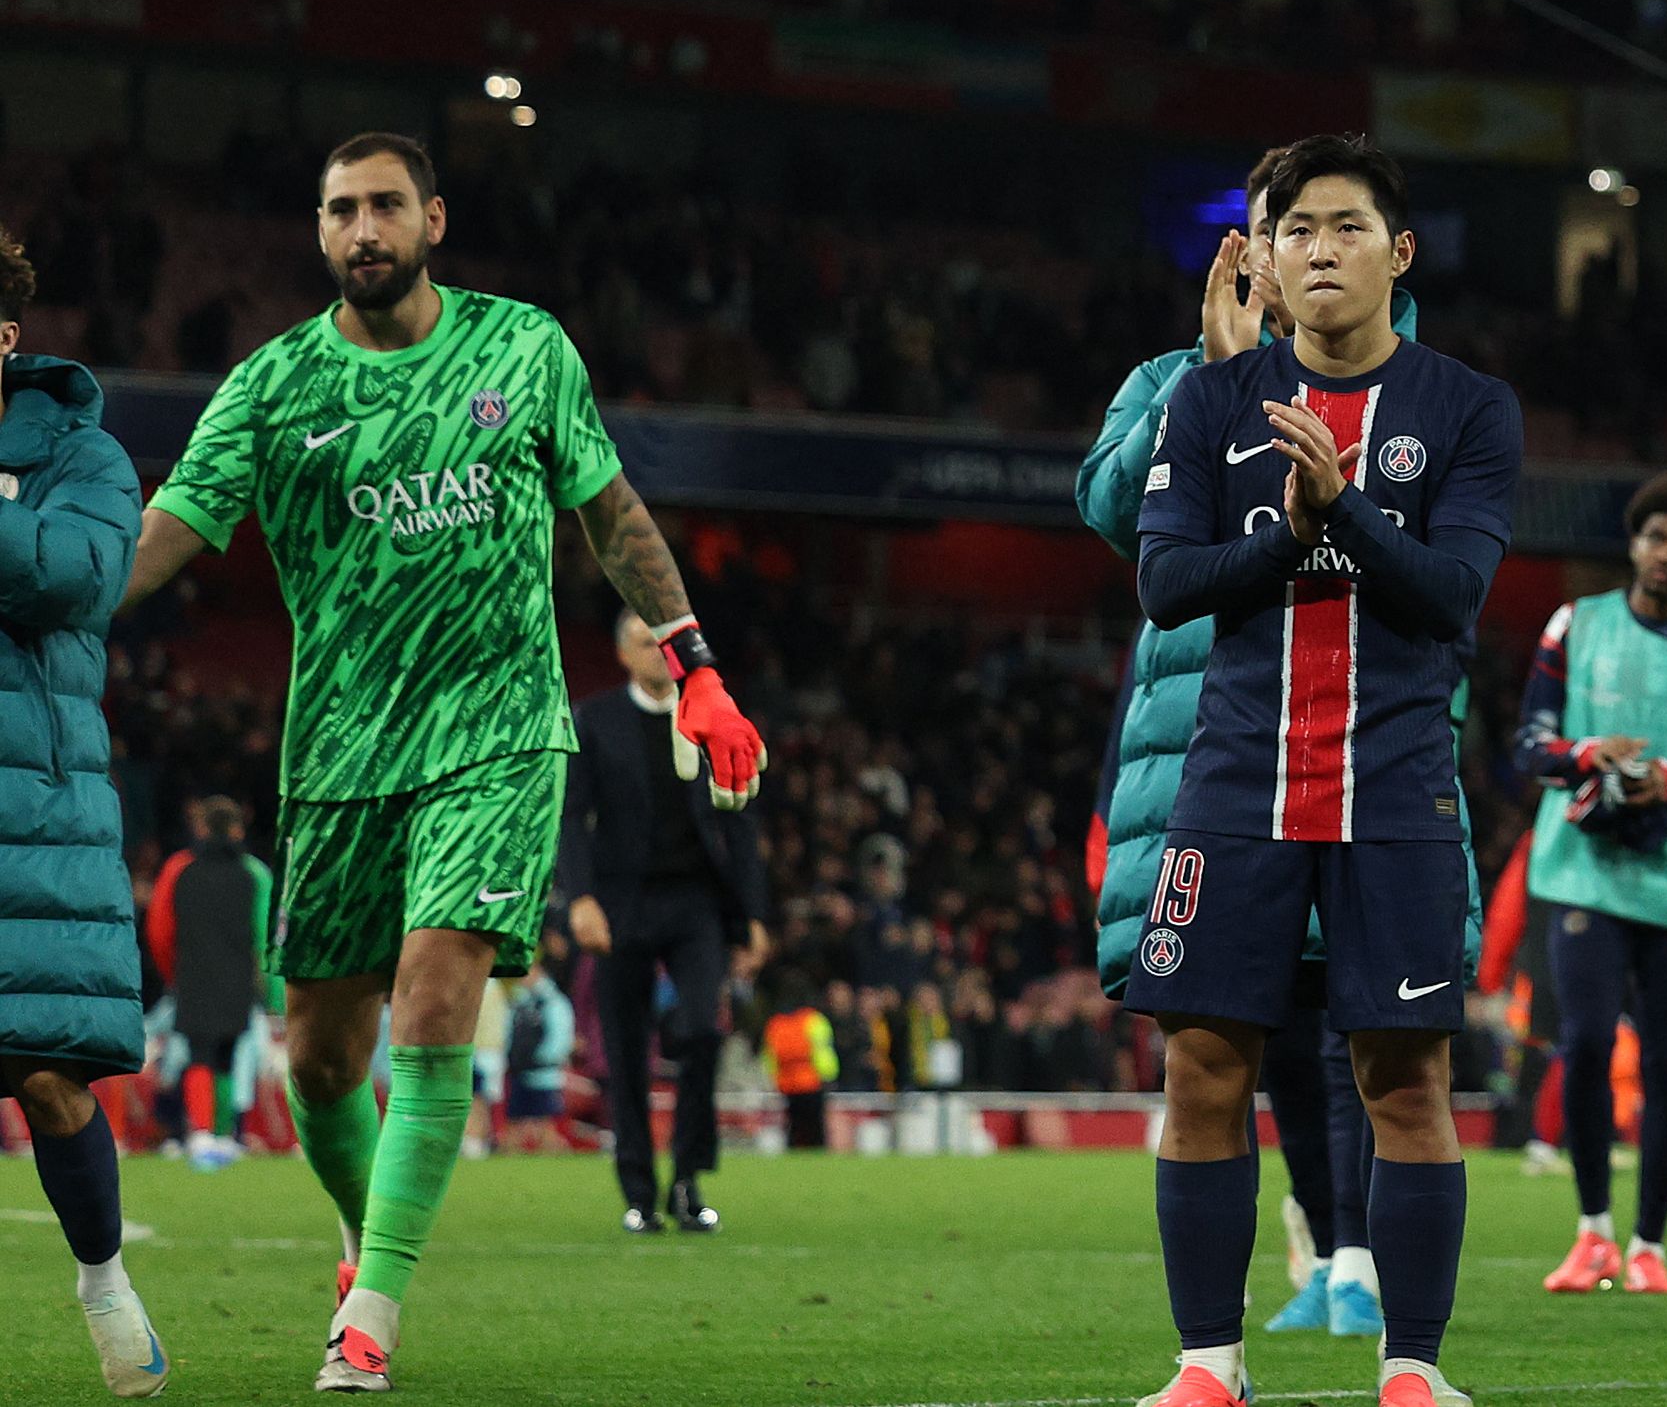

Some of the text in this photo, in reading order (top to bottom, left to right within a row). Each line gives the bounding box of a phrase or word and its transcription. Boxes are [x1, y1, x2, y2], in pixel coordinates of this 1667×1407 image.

[1389, 438, 1420, 451] PARIS
[347, 463, 494, 523] QATAR
[391, 498, 496, 538] AIRWAYS
[1150, 847, 1205, 926] 19
[1150, 931, 1178, 943] PARIS
